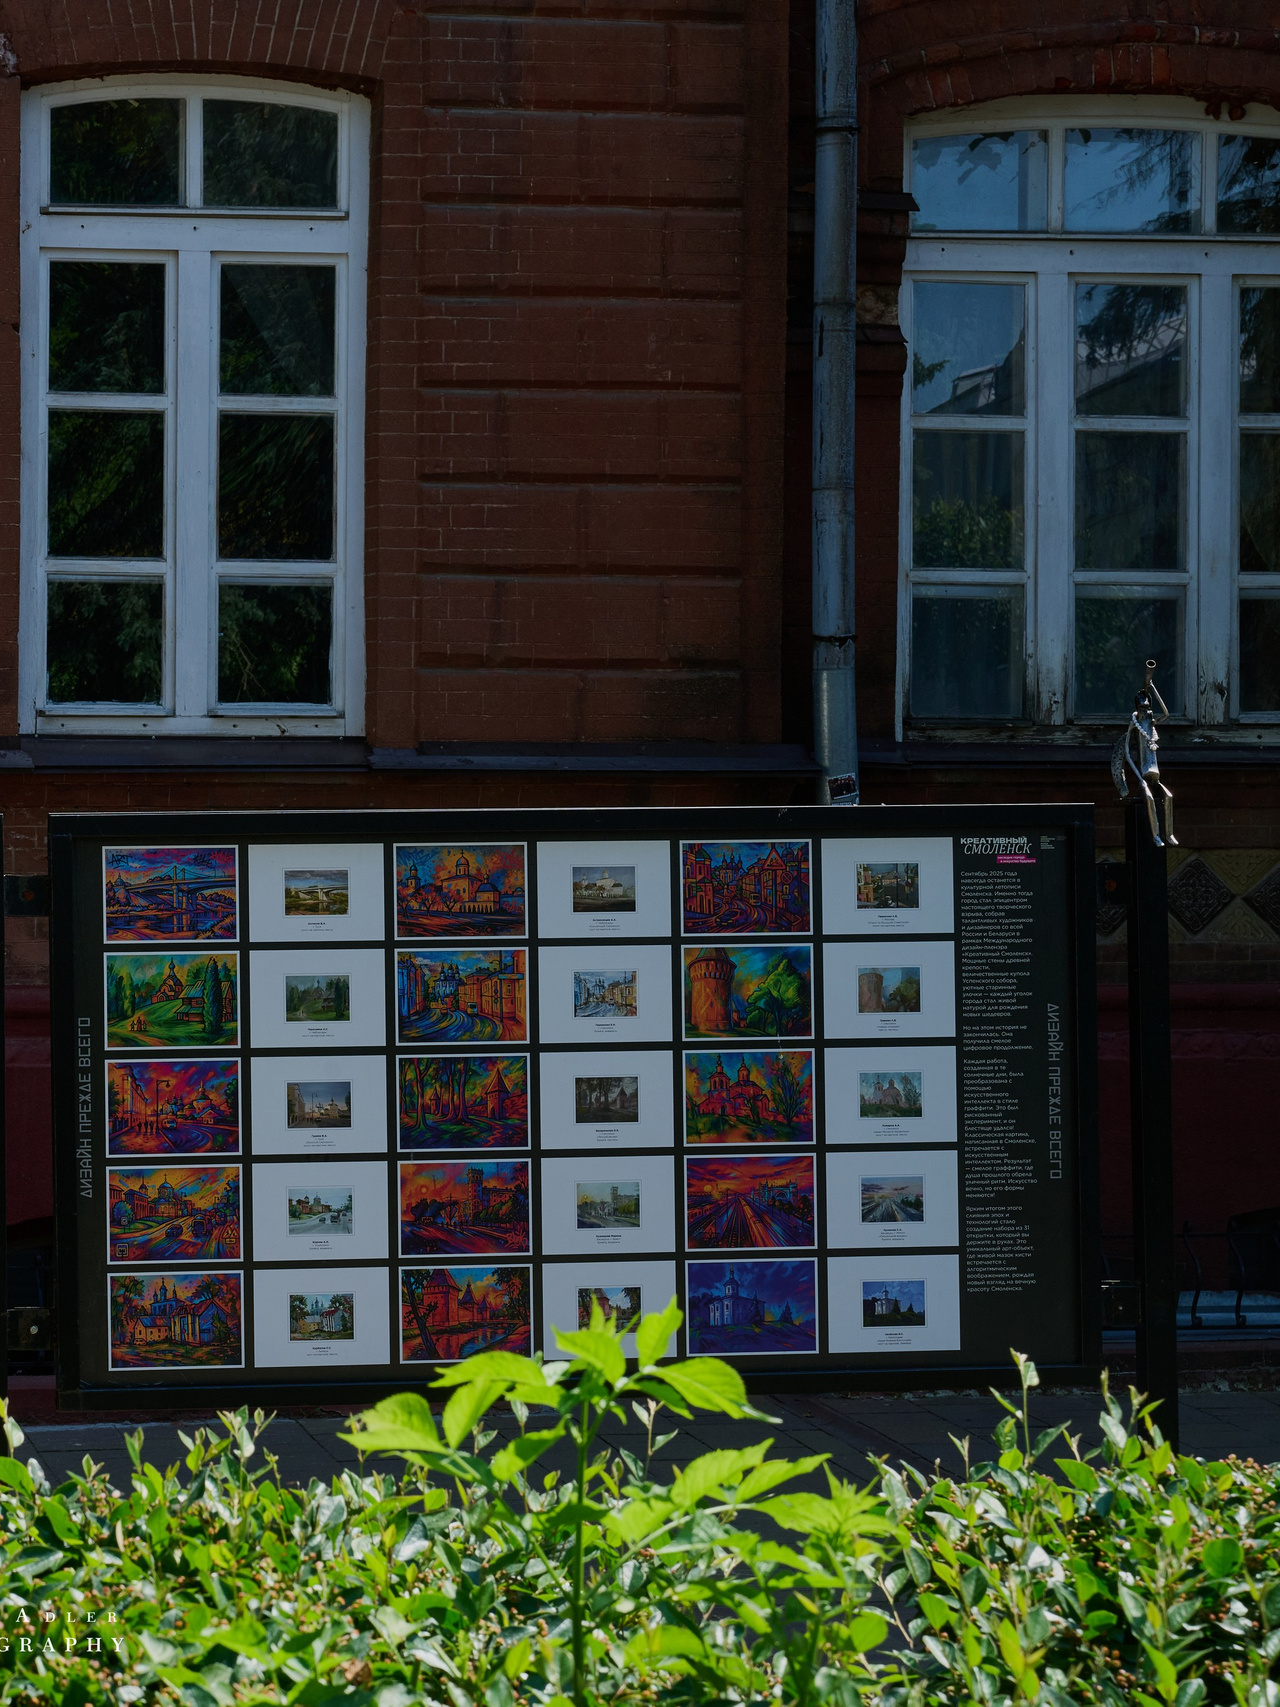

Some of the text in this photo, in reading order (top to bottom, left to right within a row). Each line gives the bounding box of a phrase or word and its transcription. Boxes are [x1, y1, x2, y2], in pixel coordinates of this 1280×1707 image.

[960, 836, 1027, 844] КРЕАТИВНЫЙ
[964, 843, 1032, 854] СМОЛЕНСК
[990, 990, 1012, 998] каждый
[963, 1044, 992, 1052] цифровое
[1047, 1003, 1064, 1179] ДИЗАЙН ПРЕЖДЕ ВСЕГО
[76, 1017, 93, 1198] ДИЗАЙН ПРЕЖДЕ ВСЕГО
